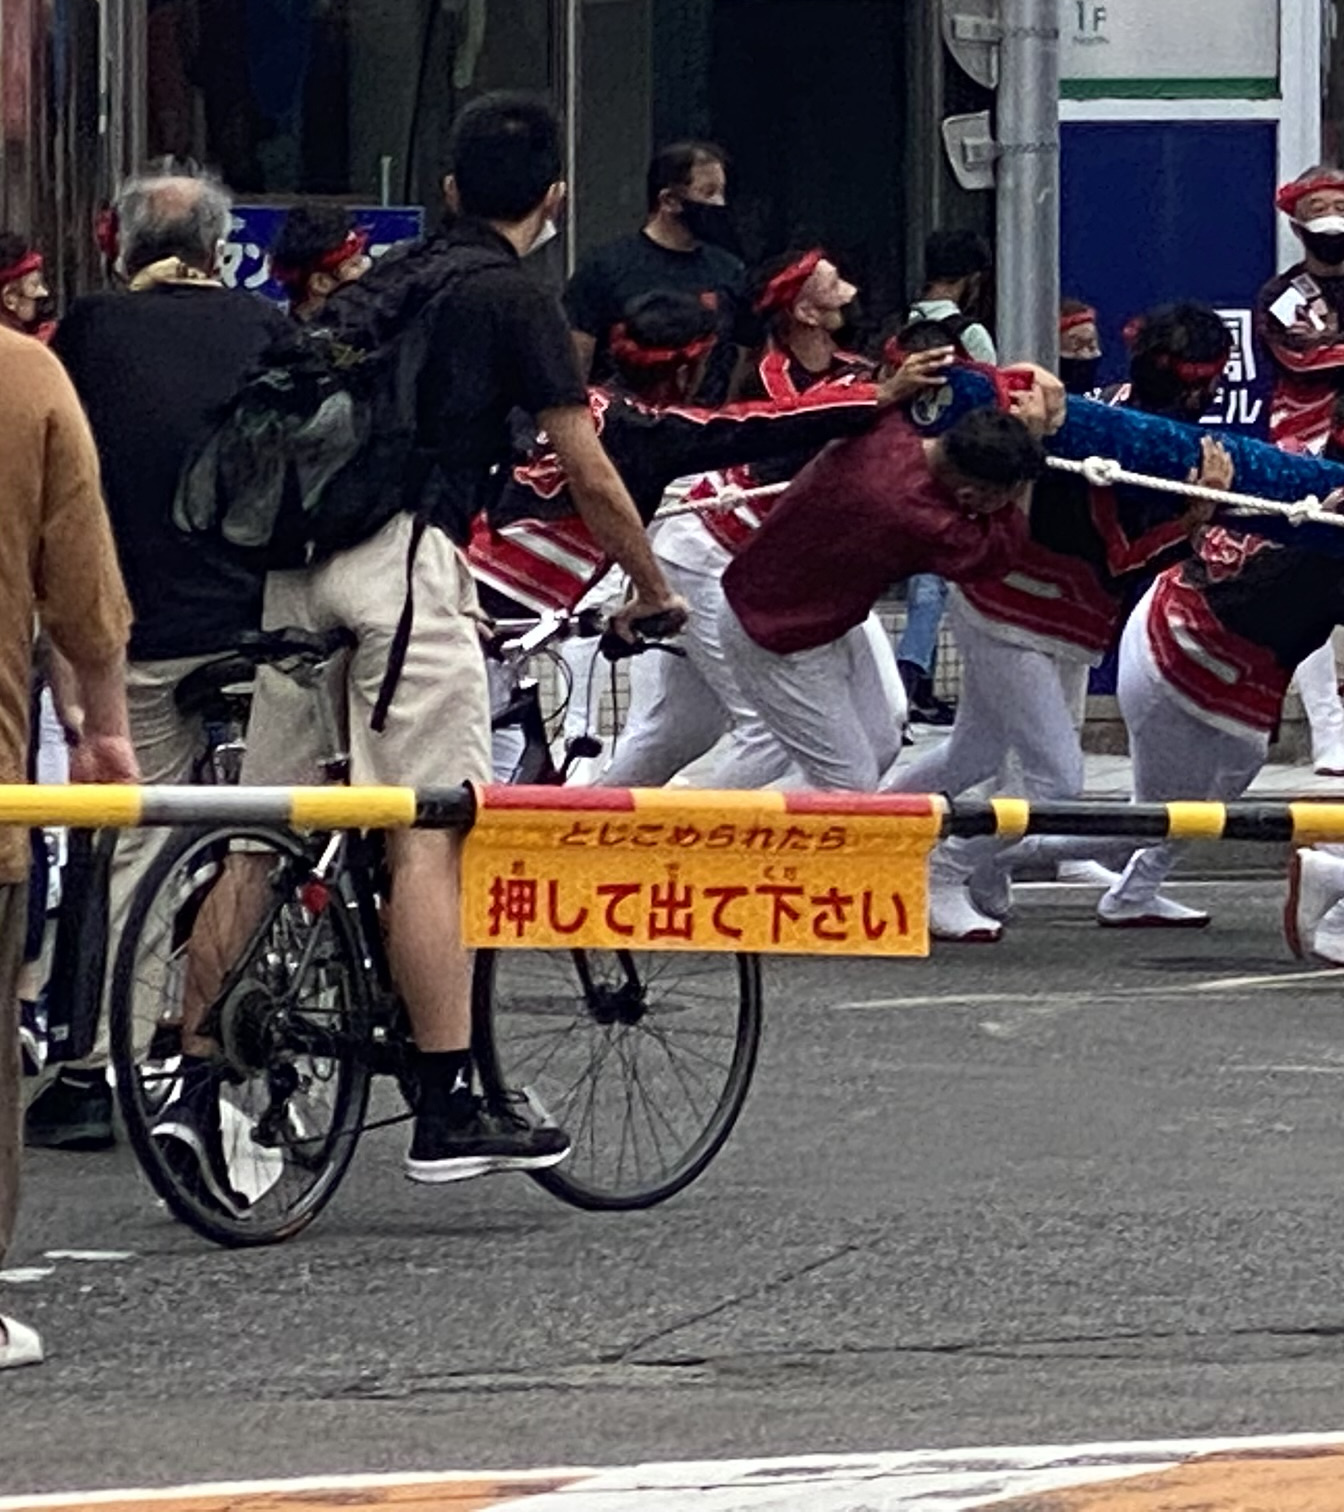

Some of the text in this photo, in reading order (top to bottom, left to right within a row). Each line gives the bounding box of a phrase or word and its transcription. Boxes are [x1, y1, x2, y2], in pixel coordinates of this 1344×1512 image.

[1076, 0, 1107, 31] 1F
[559, 821, 848, 849] とじこめられたら
[489, 875, 908, 945] 押して出て下さい
